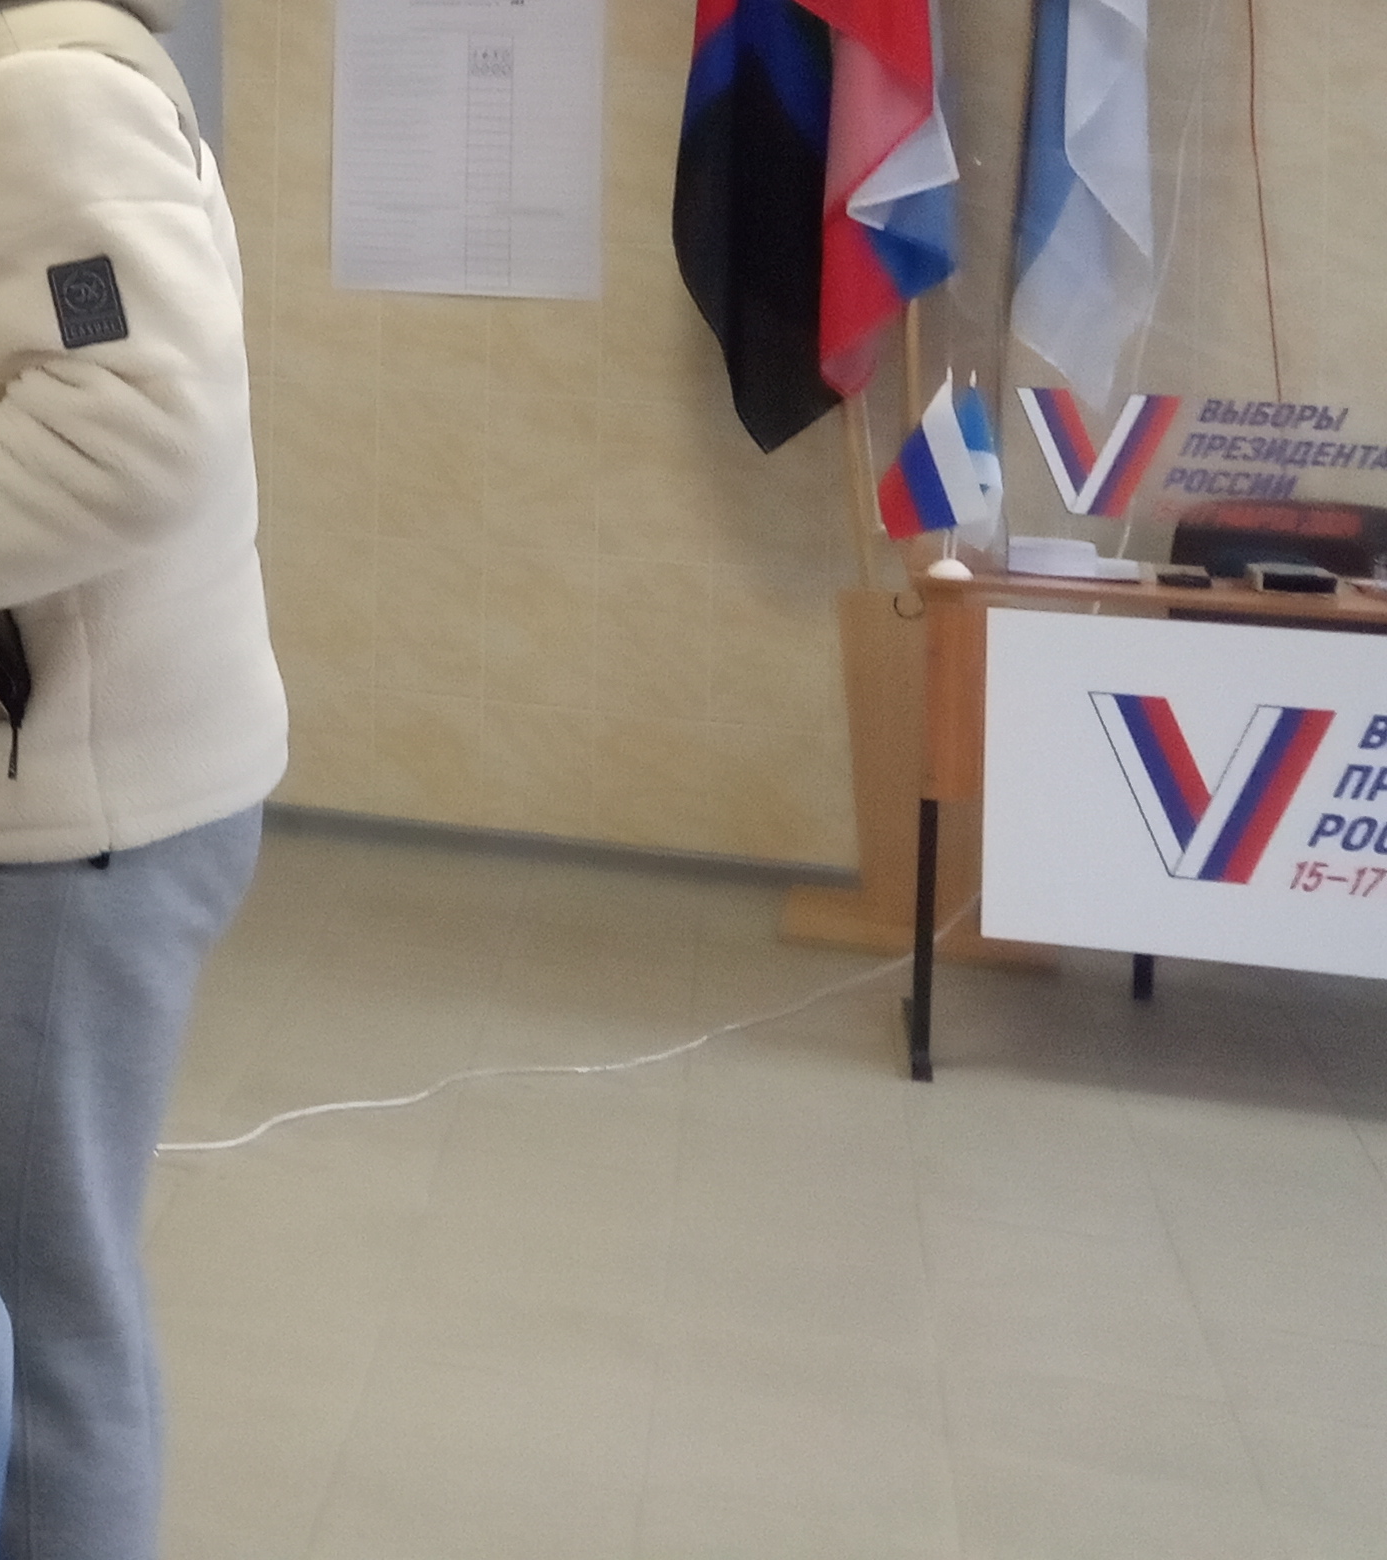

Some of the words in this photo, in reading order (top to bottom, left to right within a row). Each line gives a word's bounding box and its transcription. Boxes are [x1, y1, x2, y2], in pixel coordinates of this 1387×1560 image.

[1197, 398, 1348, 431] ВЫБОРЫ
[1179, 432, 1387, 469] ПРЕЗИДЕНТА
[1164, 467, 1299, 497] РОССИИ
